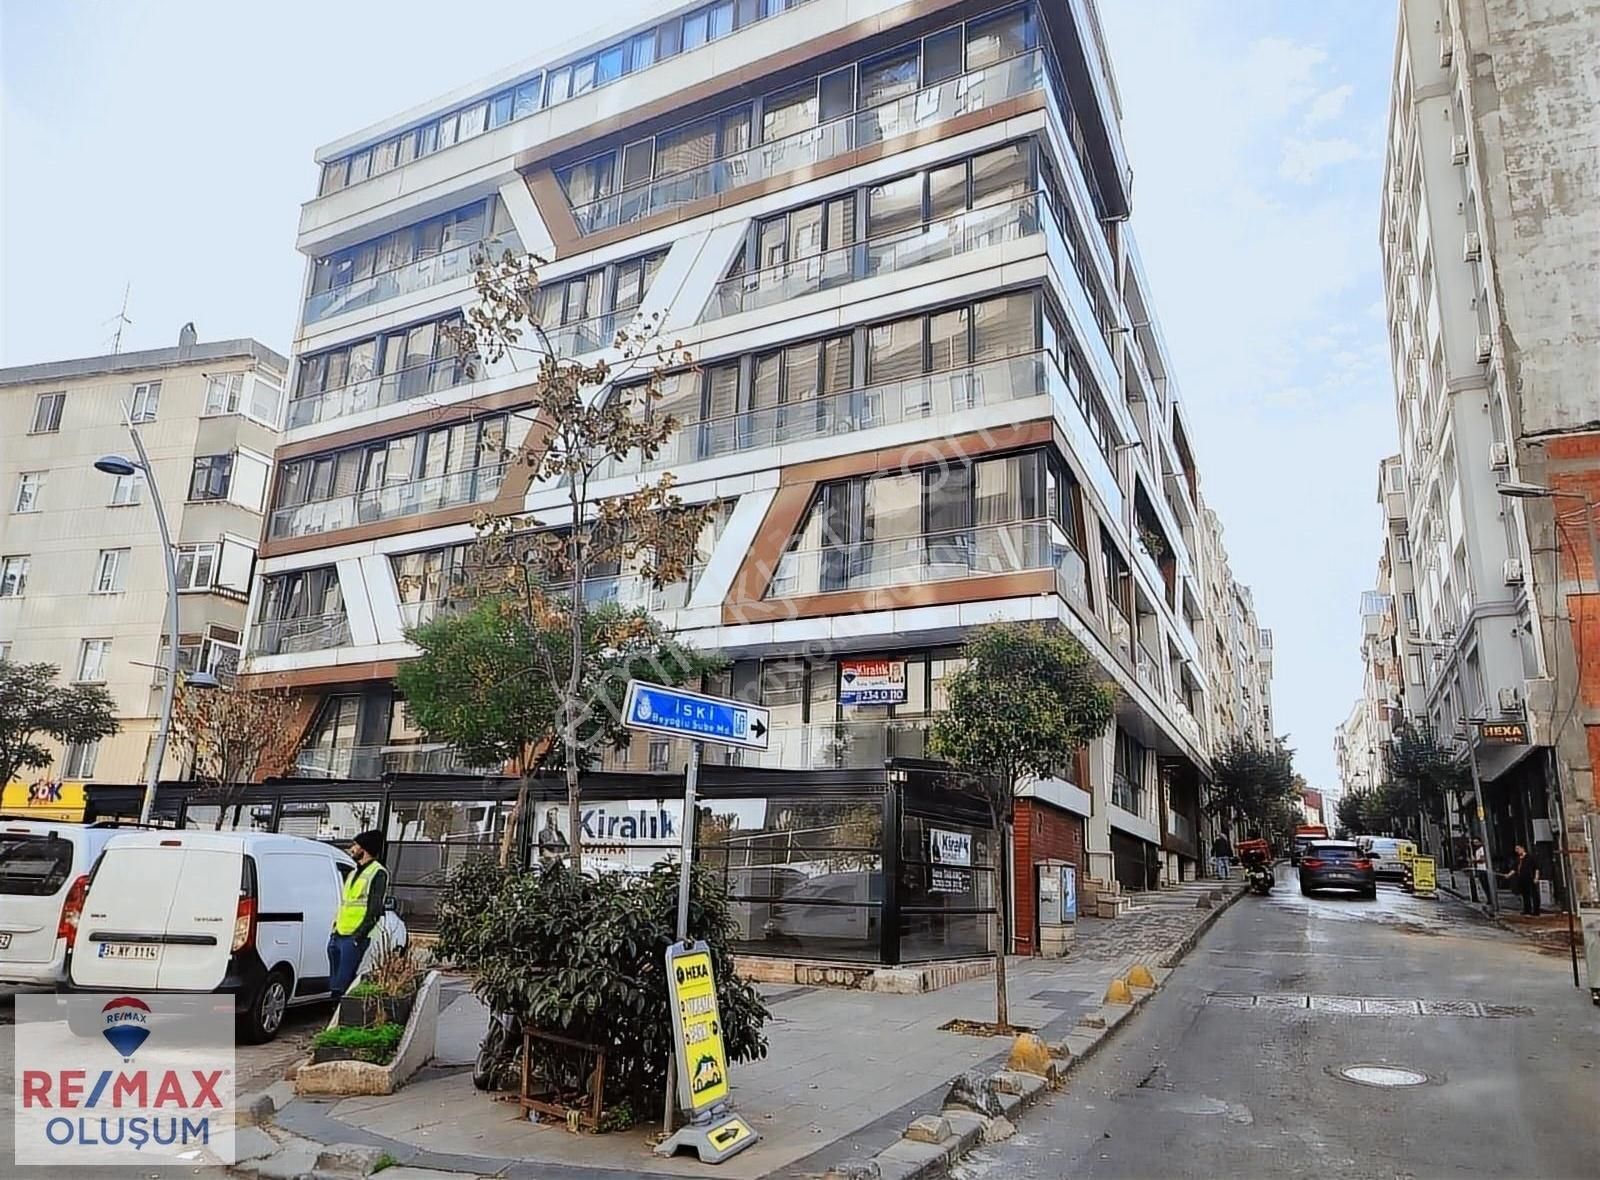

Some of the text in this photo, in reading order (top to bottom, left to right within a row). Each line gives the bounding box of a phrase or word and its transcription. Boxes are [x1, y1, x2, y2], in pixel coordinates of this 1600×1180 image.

[675, 699, 714, 720] İSKİ
[1483, 726, 1522, 737] HEXA
[579, 809, 676, 838] Kiralık
[685, 964, 709, 981] HEXA
